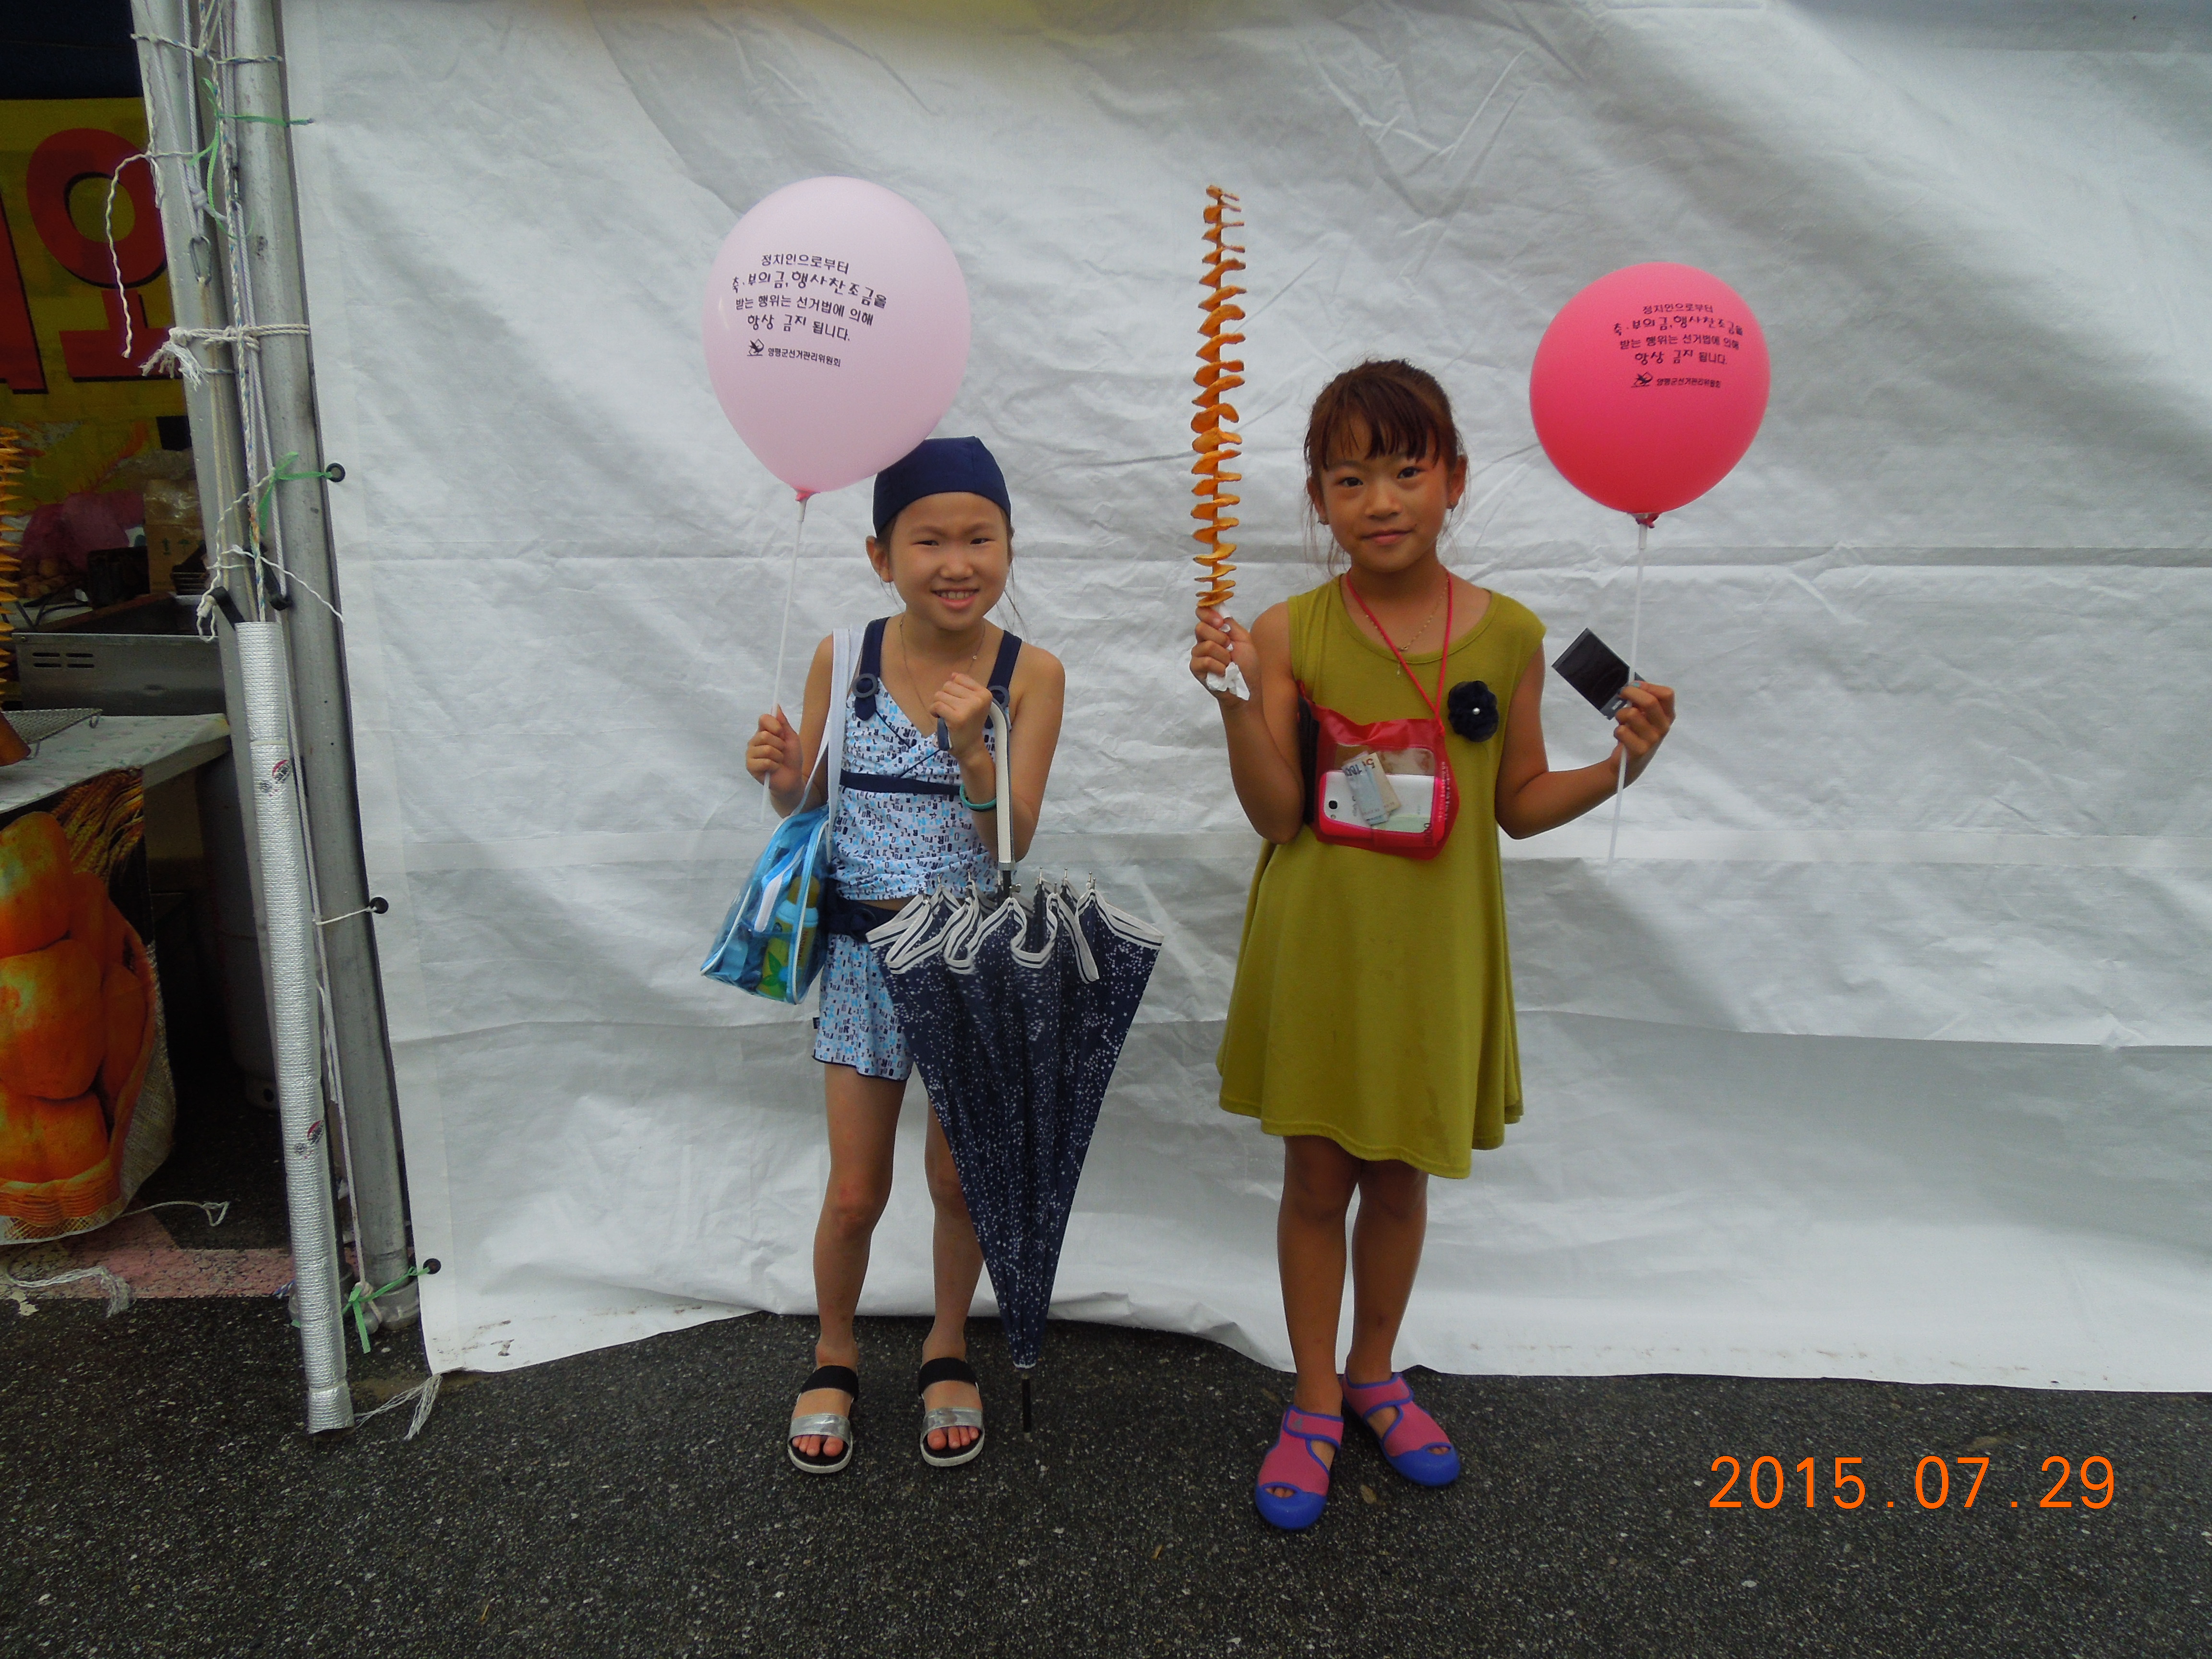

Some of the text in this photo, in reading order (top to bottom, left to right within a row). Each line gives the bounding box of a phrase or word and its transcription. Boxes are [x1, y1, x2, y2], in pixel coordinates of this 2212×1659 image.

[761, 253, 849, 275] 정치인으로부터
[736, 294, 874, 326] 받는 행위는 선거법에 의해
[1643, 303, 1713, 314] 정치인으로부터
[747, 314, 850, 341] 항상 금지 됩니다.
[1620, 339, 1642, 349] 받는
[1646, 335, 1679, 346] 행위는
[1683, 334, 1720, 345] 선거법에
[768, 348, 841, 367] 양평군선거관리위원회
[1635, 351, 1665, 365] 항상
